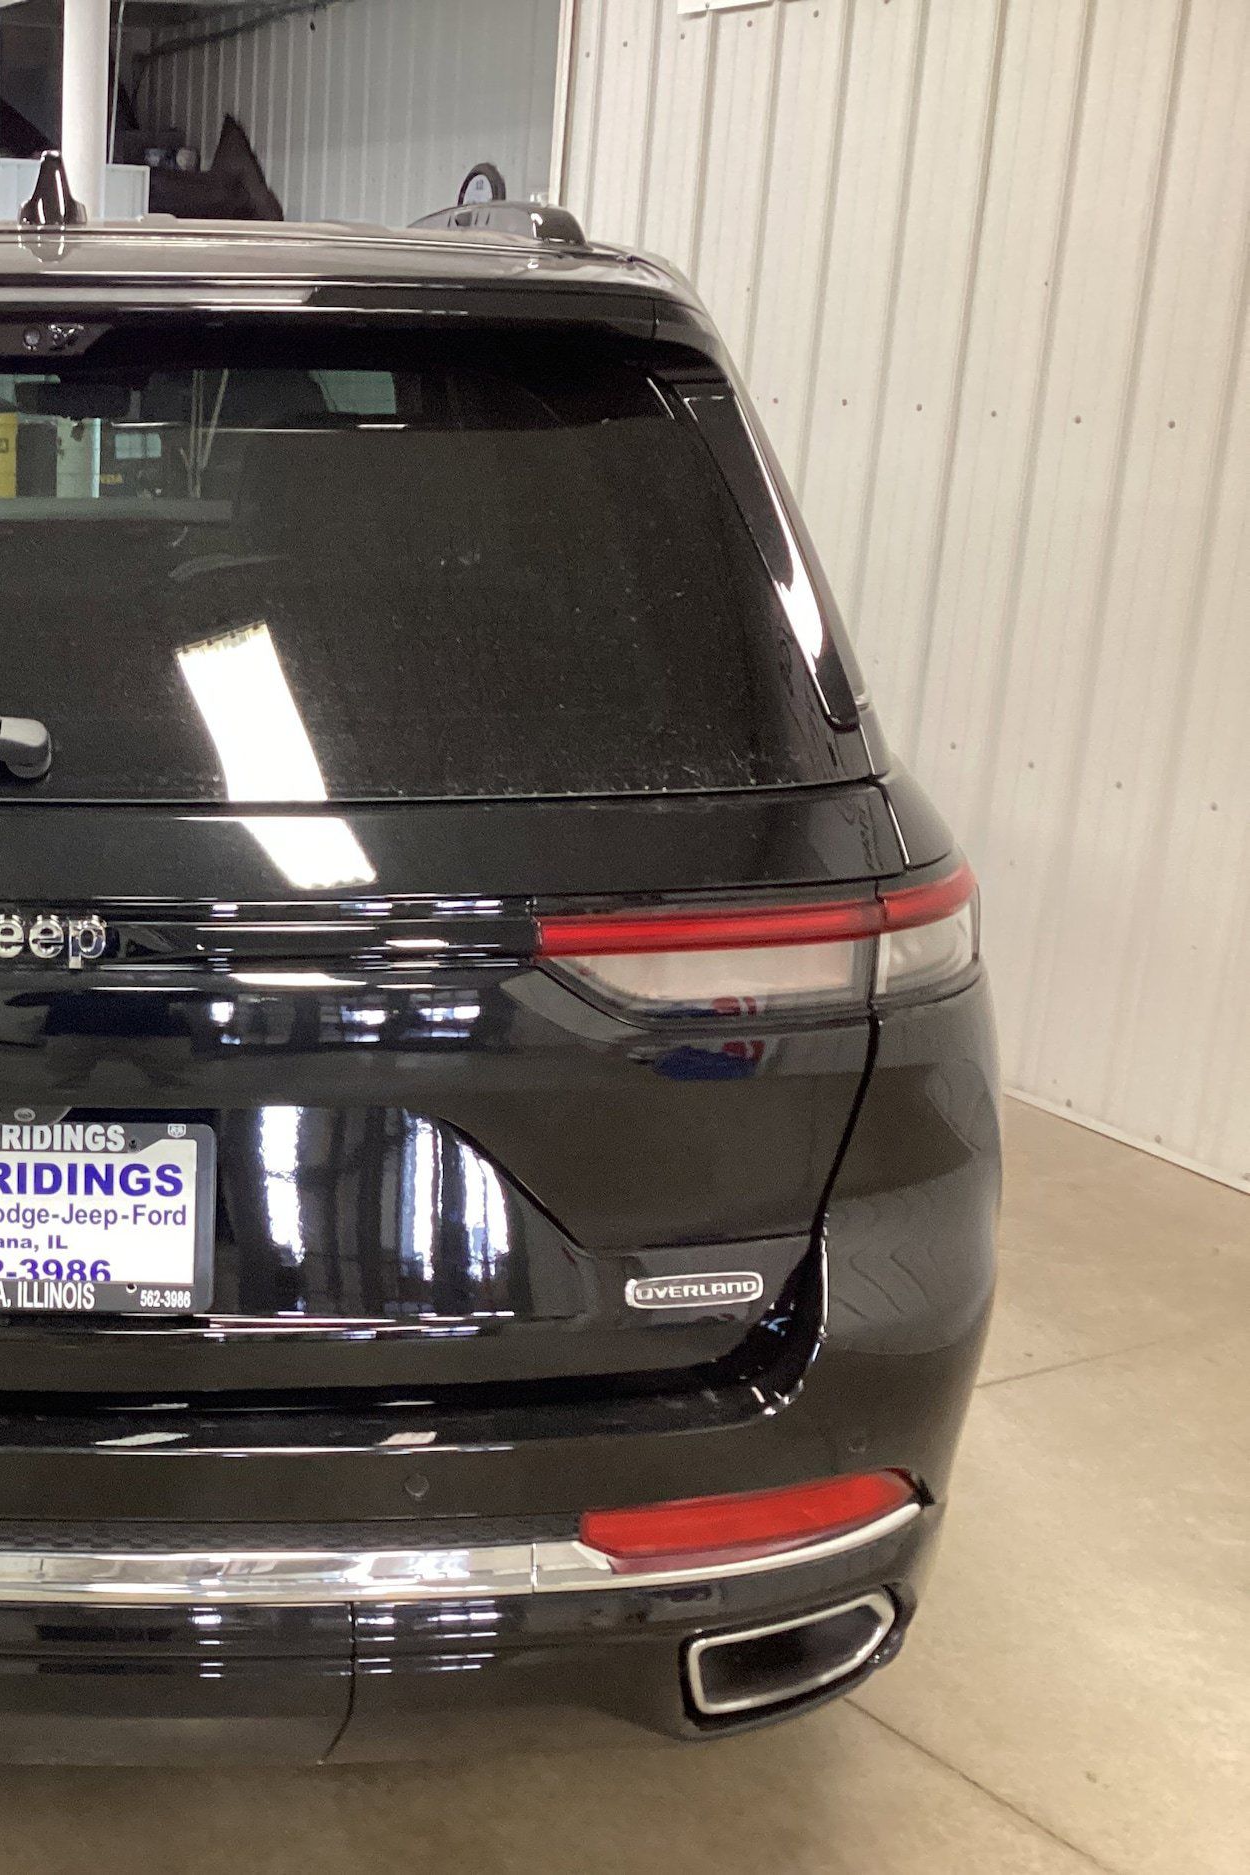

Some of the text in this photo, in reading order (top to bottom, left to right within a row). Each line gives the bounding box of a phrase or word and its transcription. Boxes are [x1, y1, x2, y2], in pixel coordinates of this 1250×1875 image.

[2, 1124, 126, 1151] RIDINGS
[48, 1235, 68, 1249] IL
[18, 1281, 95, 1310] ILLINOIS
[140, 1290, 191, 1308] 562-3986
[635, 1280, 758, 1300] OVERLAND
